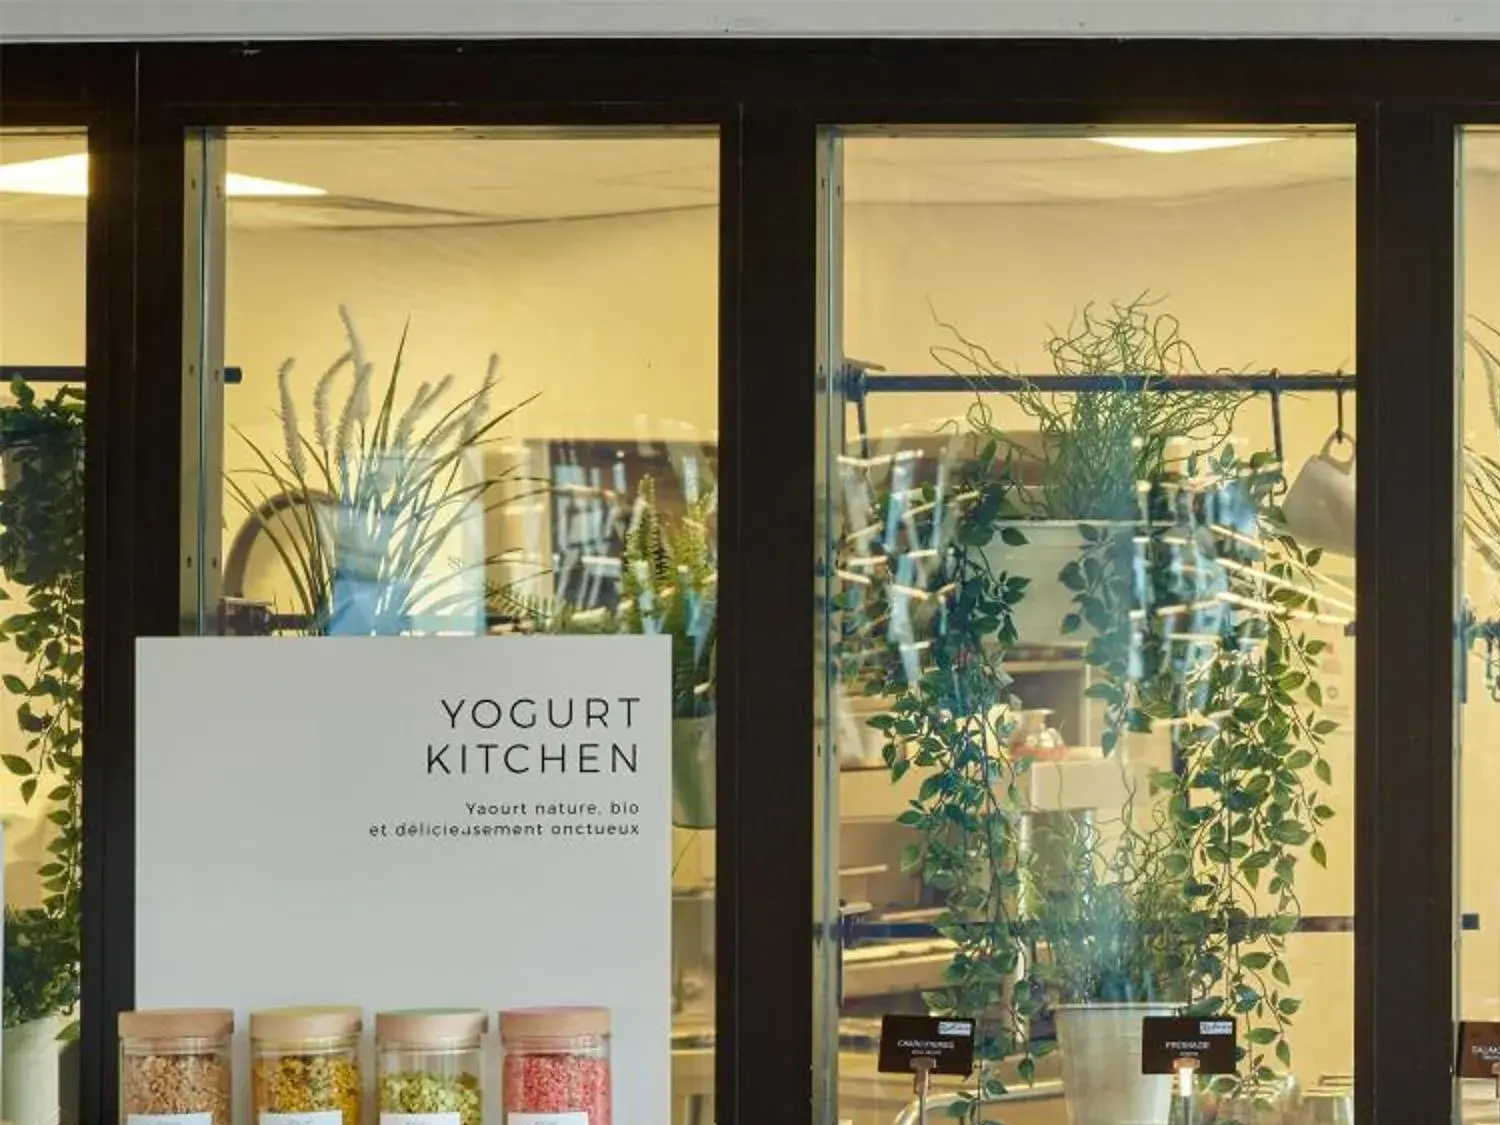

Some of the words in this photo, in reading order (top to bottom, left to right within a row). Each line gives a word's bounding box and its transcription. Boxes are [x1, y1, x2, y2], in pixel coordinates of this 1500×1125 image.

[440, 697, 641, 729] YOGURT
[426, 743, 638, 775] KITCHEN
[465, 801, 527, 816] Yaourt
[611, 801, 640, 815] bio
[369, 823, 388, 837] et
[551, 822, 640, 836] onctueux
